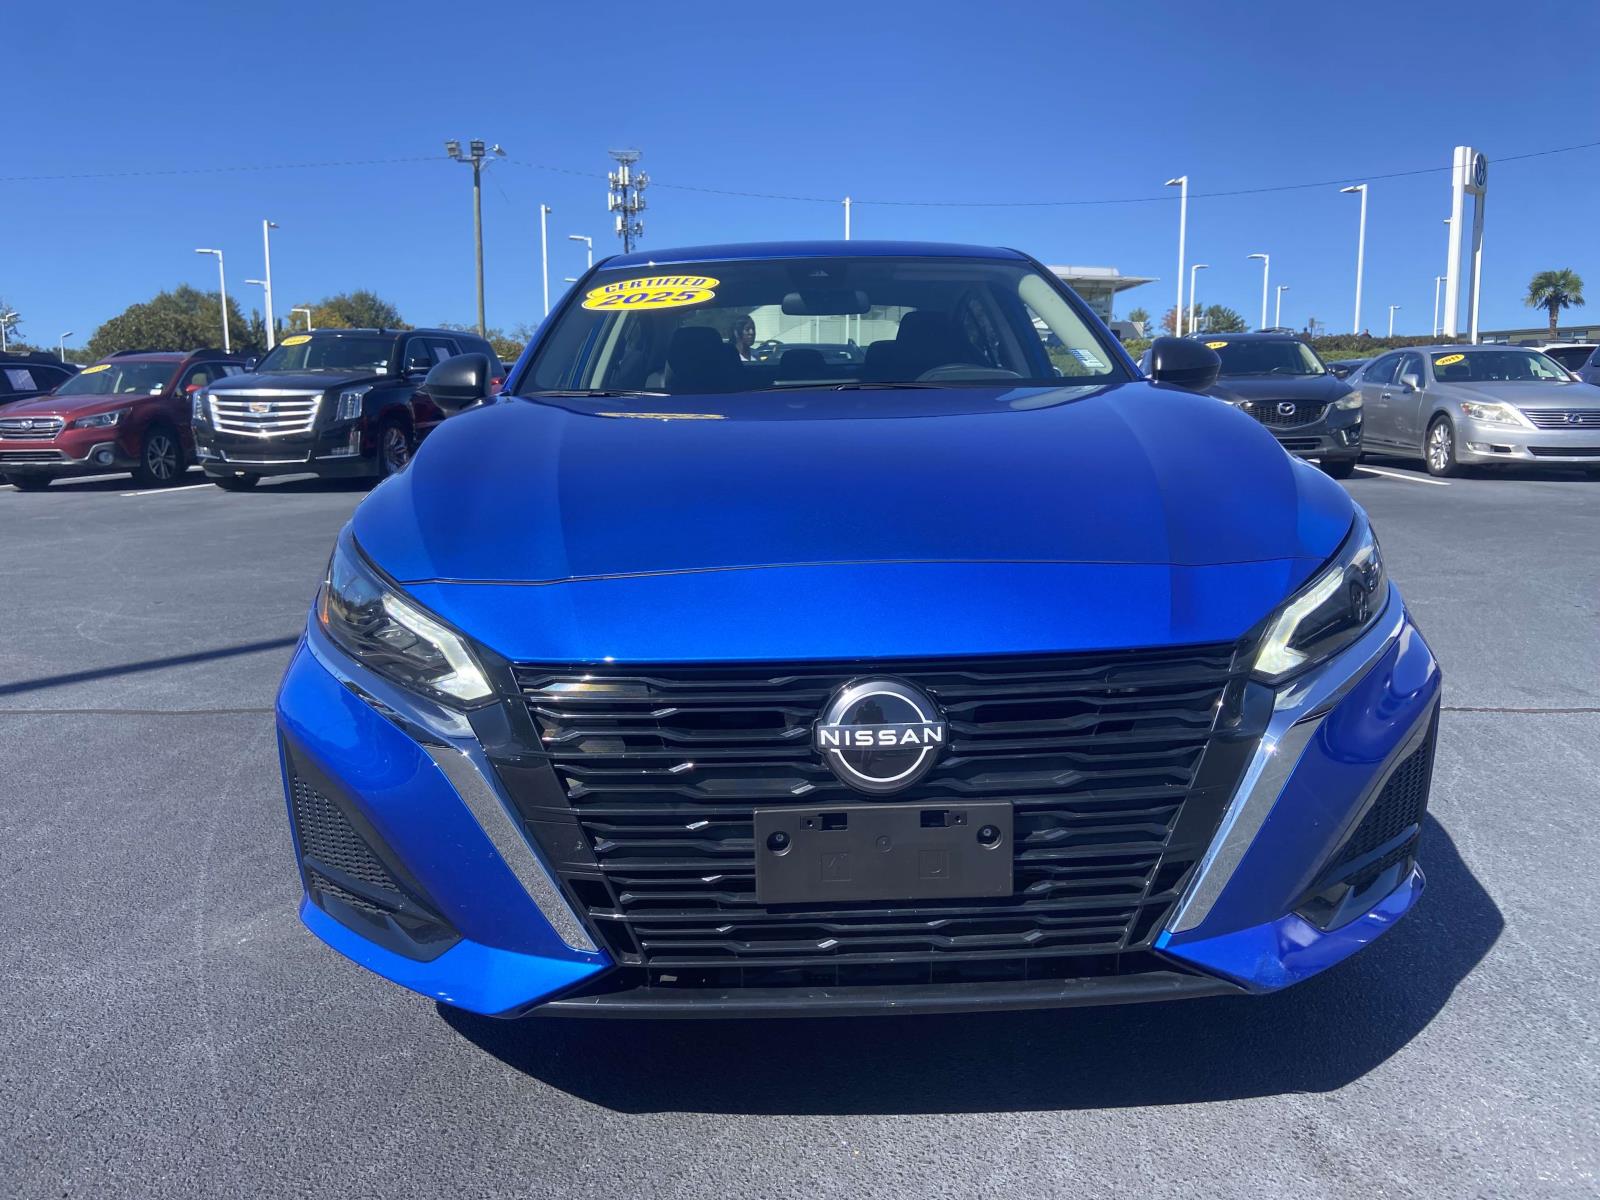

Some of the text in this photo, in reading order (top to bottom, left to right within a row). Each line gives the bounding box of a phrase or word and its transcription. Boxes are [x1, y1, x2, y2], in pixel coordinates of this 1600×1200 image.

[604, 277, 706, 293] CERTIFIED
[596, 290, 700, 306] 2025
[820, 726, 942, 746] NISSAN
